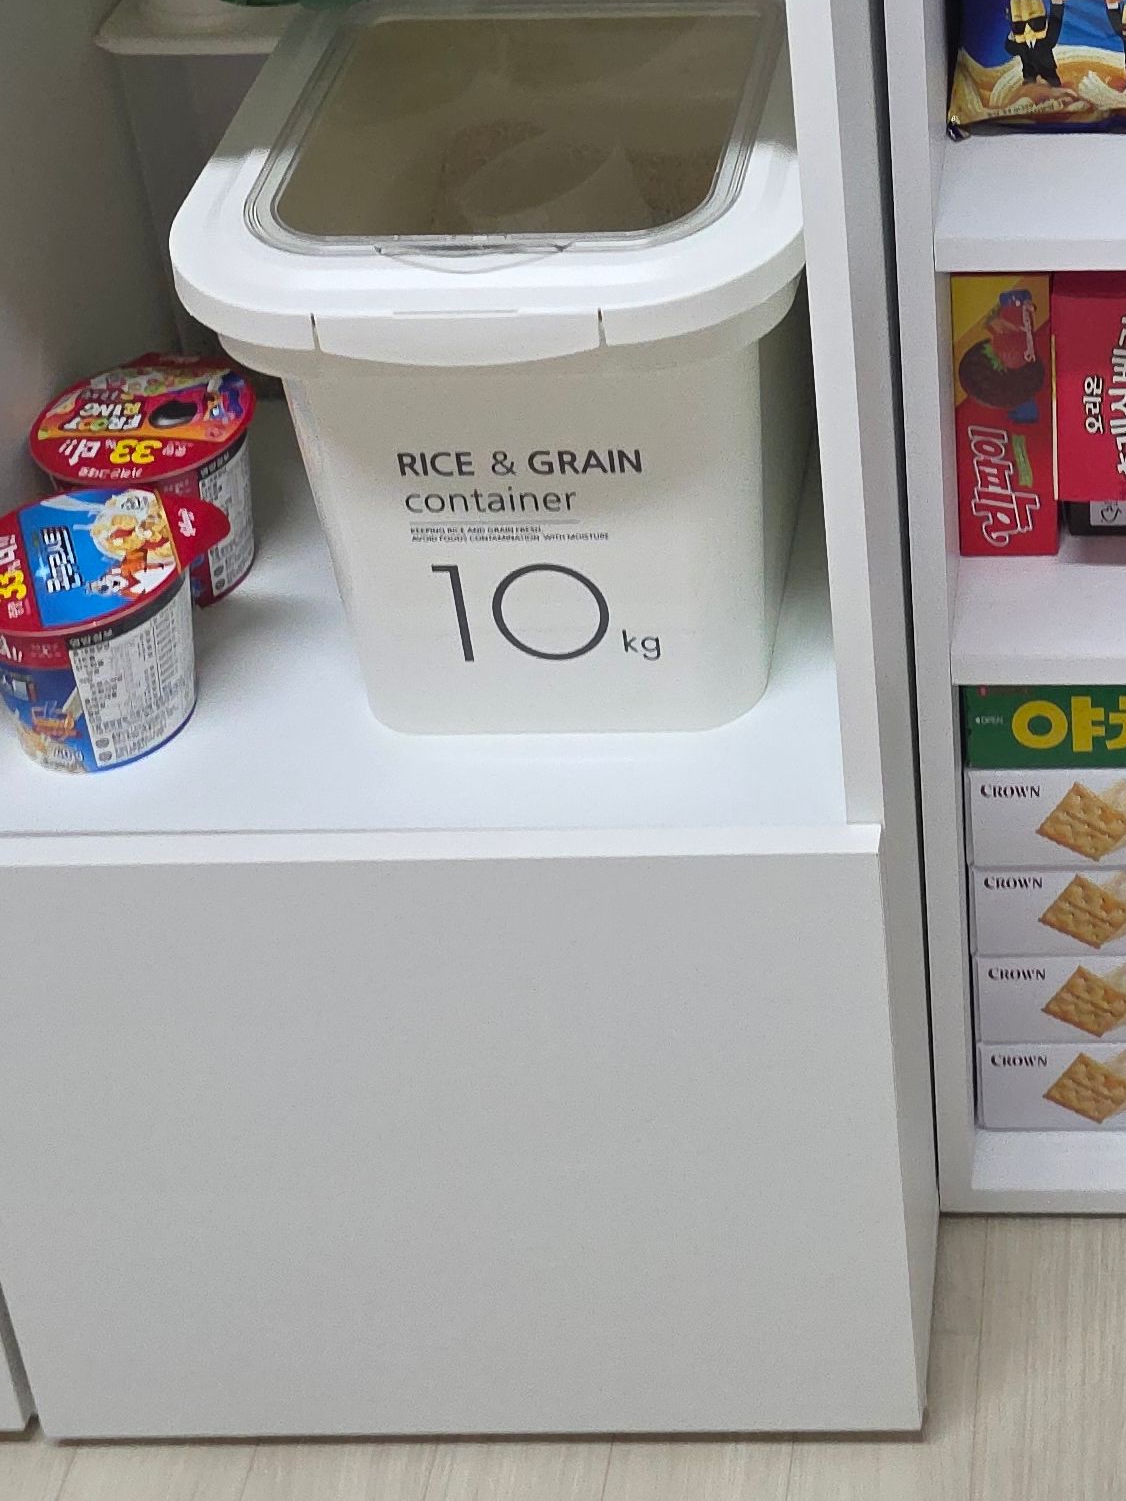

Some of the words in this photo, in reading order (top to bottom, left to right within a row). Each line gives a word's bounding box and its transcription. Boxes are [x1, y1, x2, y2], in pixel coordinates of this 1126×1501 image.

[1081, 373, 1105, 436] 오리온
[396, 451, 475, 477] RICE
[491, 450, 517, 477] &
[527, 449, 643, 475] GRAIN
[405, 486, 577, 513] container
[430, 562, 610, 662] 10
[621, 629, 661, 661] kg
[980, 784, 1041, 798] CROWN
[984, 877, 1043, 890] CROWN
[988, 967, 1047, 981] CROWN
[990, 1055, 1048, 1068] CROWN
